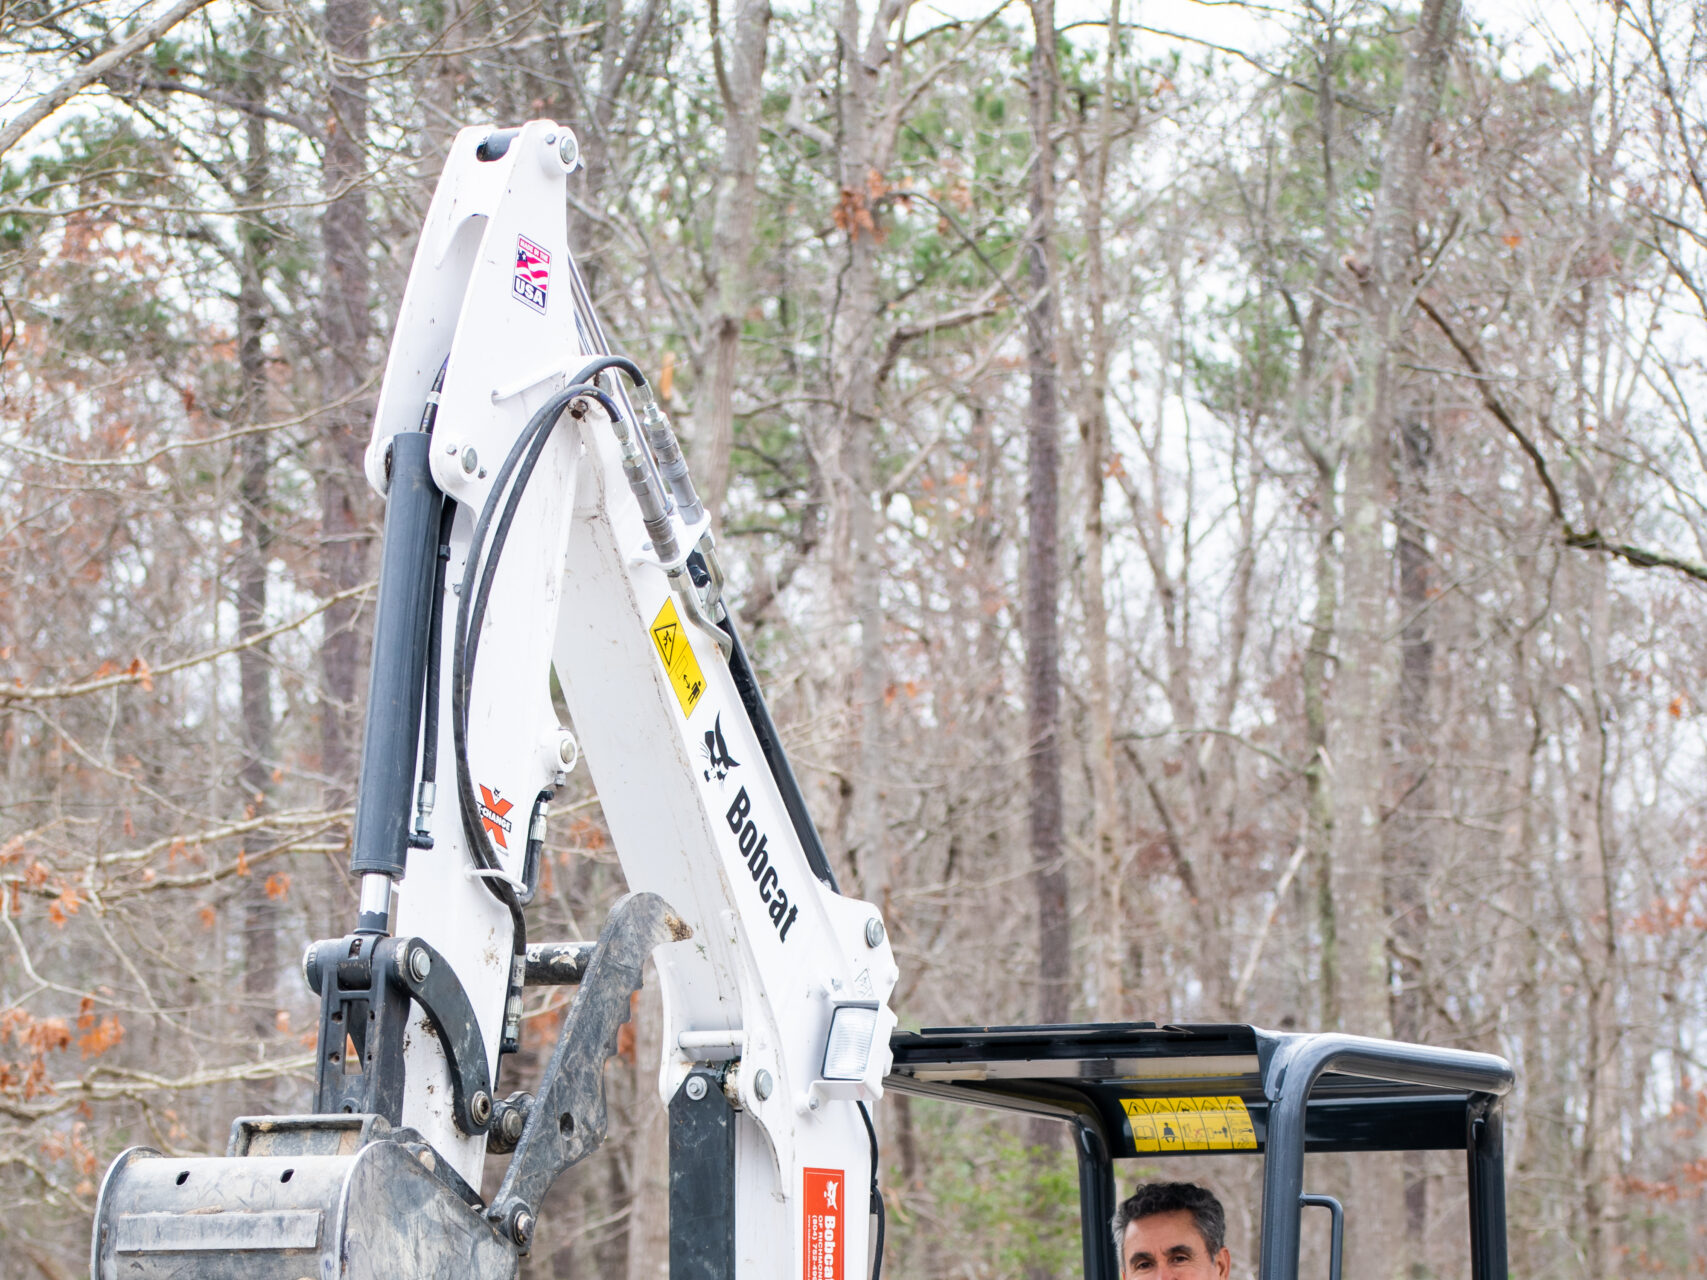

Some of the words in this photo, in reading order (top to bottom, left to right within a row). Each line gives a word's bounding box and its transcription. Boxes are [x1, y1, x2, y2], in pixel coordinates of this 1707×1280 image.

[515, 276, 545, 307] USA
[726, 786, 799, 944] Bobcat
[818, 1215, 823, 1229] OF
